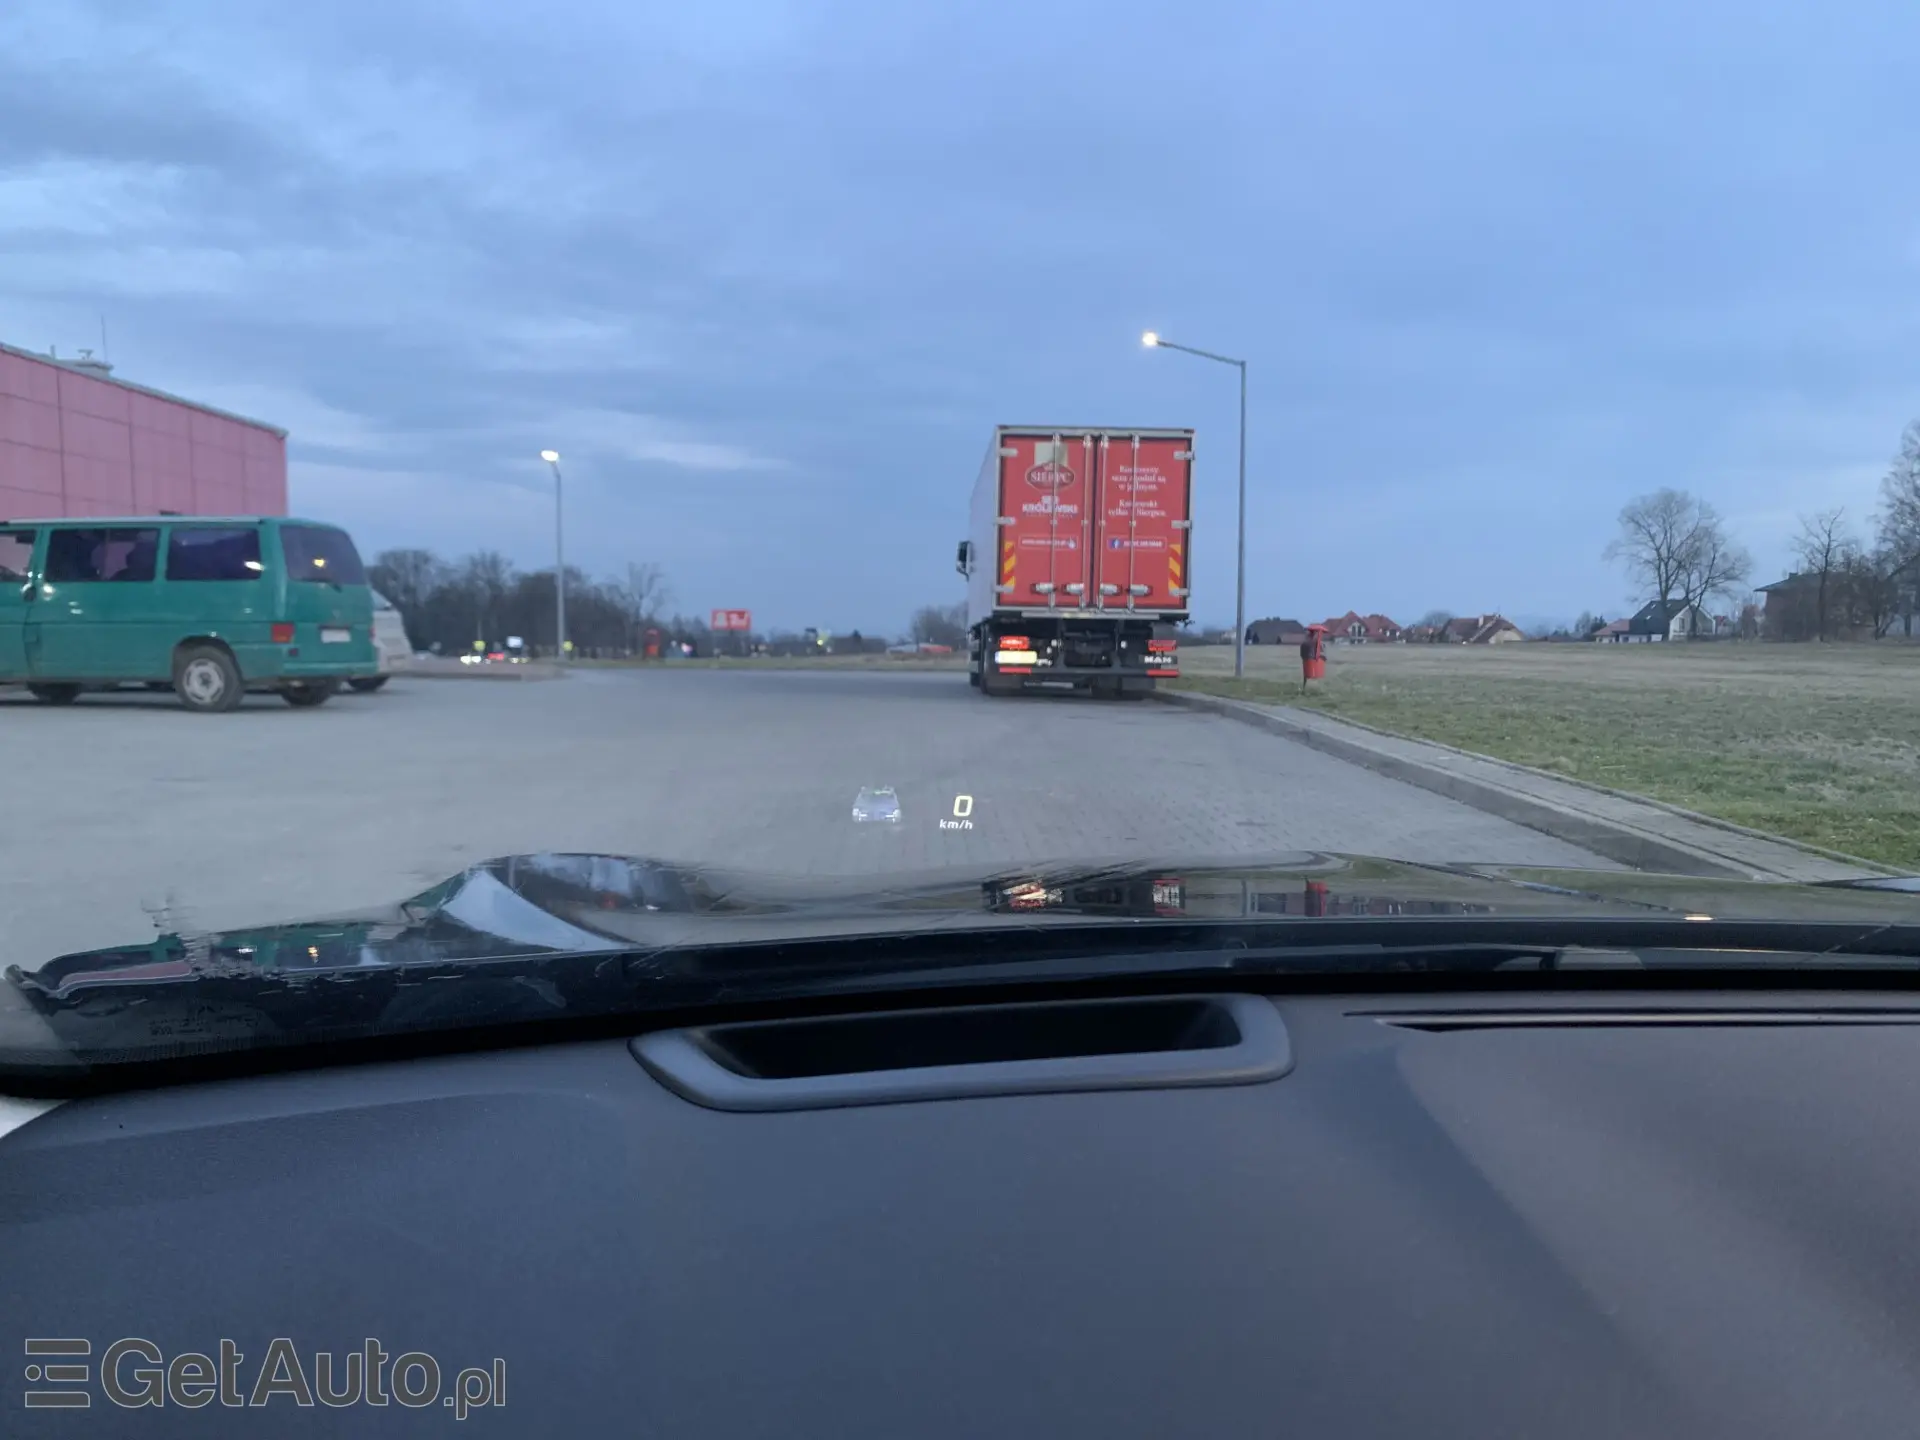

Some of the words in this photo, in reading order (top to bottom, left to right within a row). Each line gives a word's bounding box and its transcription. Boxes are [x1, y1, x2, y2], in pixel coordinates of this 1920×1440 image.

[1144, 655, 1172, 664] MAN
[953, 795, 973, 817] 0
[939, 819, 973, 829] km/h
